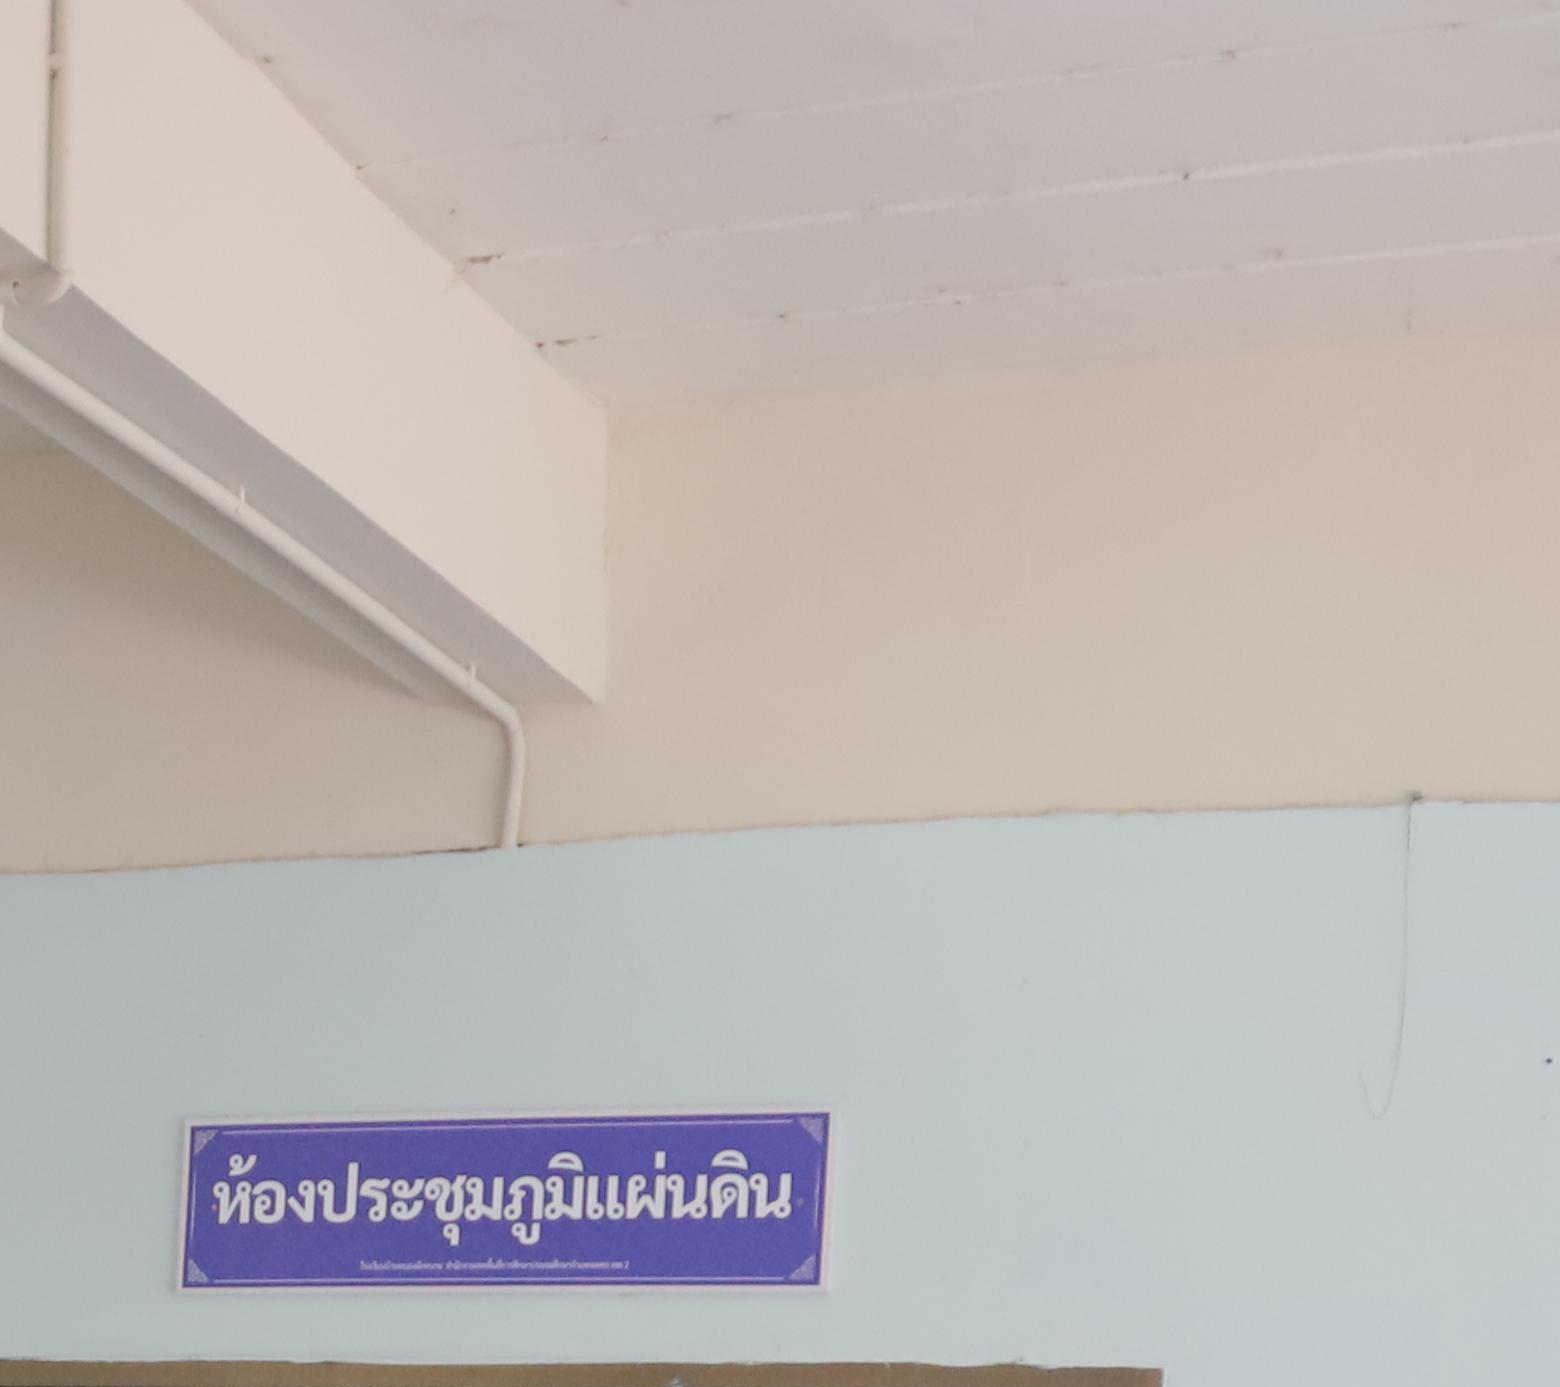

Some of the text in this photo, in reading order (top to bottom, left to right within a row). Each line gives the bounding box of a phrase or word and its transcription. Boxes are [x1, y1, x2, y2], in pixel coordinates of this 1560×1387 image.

[212, 1148, 793, 1247] ห้องประชุมภูมิแผ่นดิน
